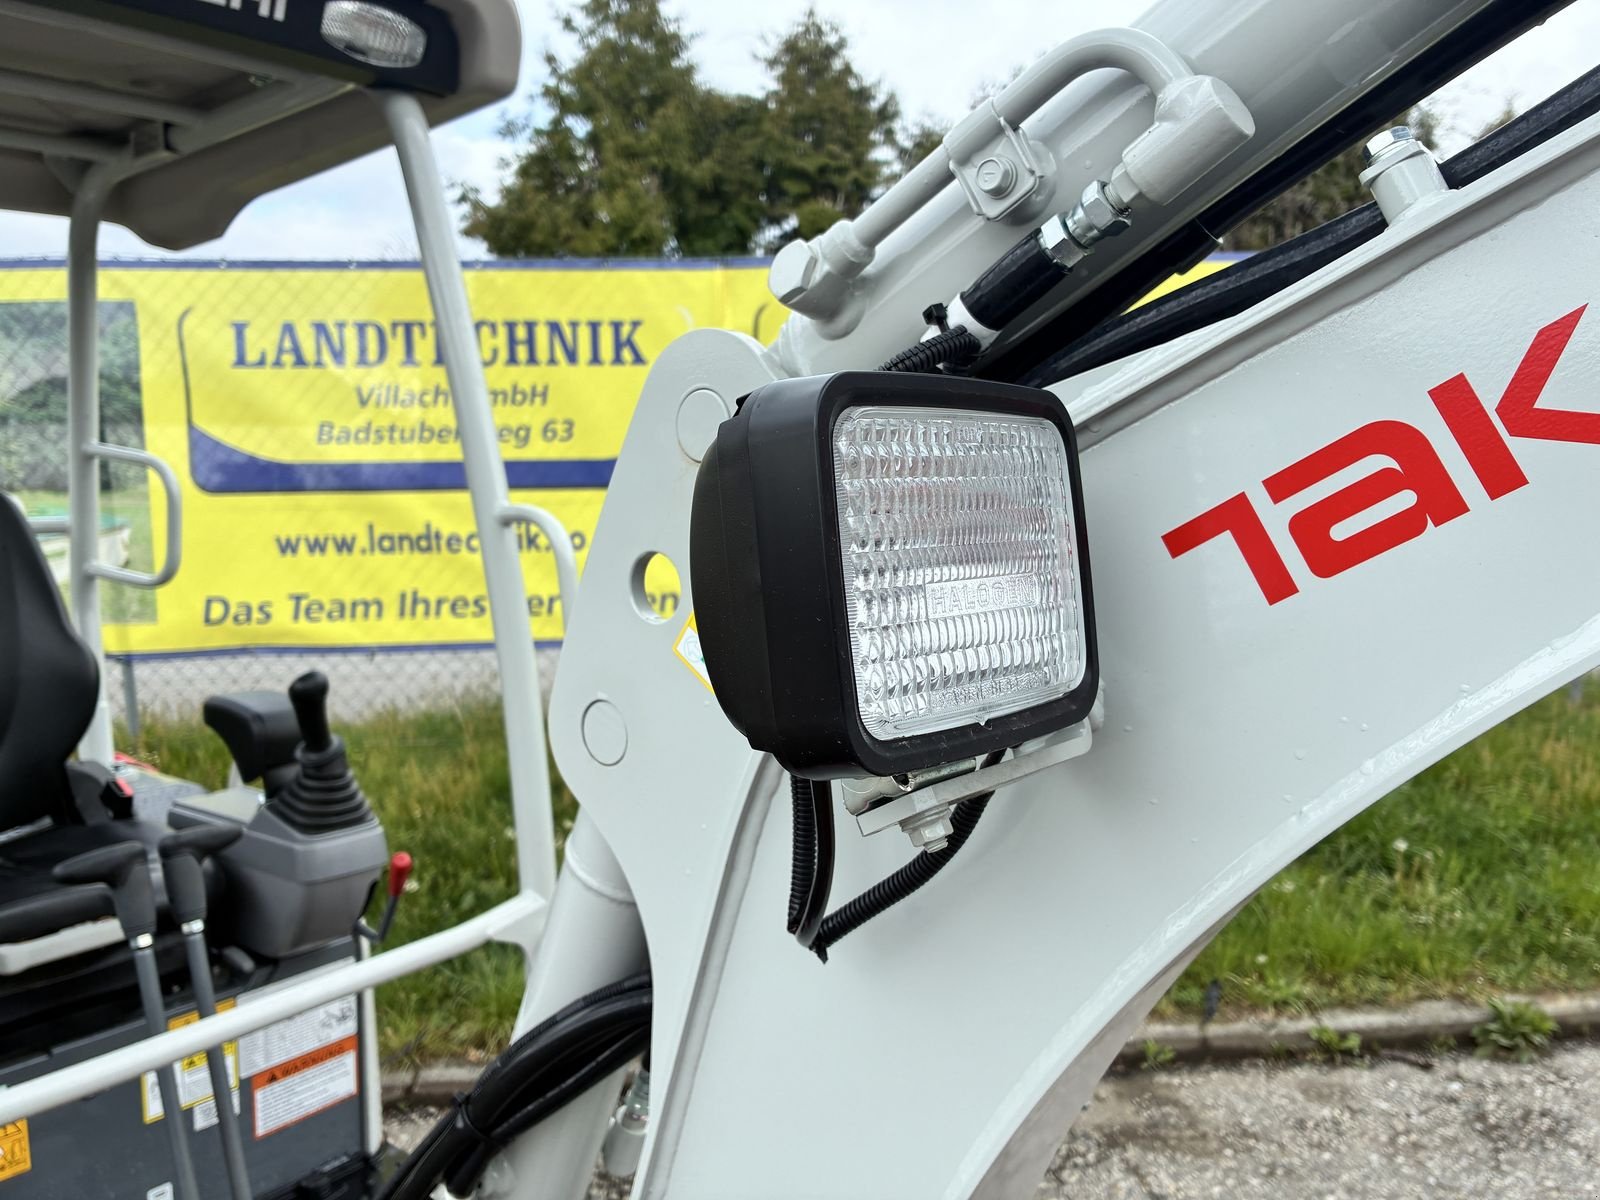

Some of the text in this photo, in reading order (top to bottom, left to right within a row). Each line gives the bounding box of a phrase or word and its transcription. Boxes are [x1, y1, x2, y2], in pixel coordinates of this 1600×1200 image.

[355, 382, 549, 409] Villach mbH
[316, 418, 576, 449] Badstubeeg 63
[203, 588, 487, 627] Das Team Ihres
[930, 573, 1036, 615] HALOGEN
